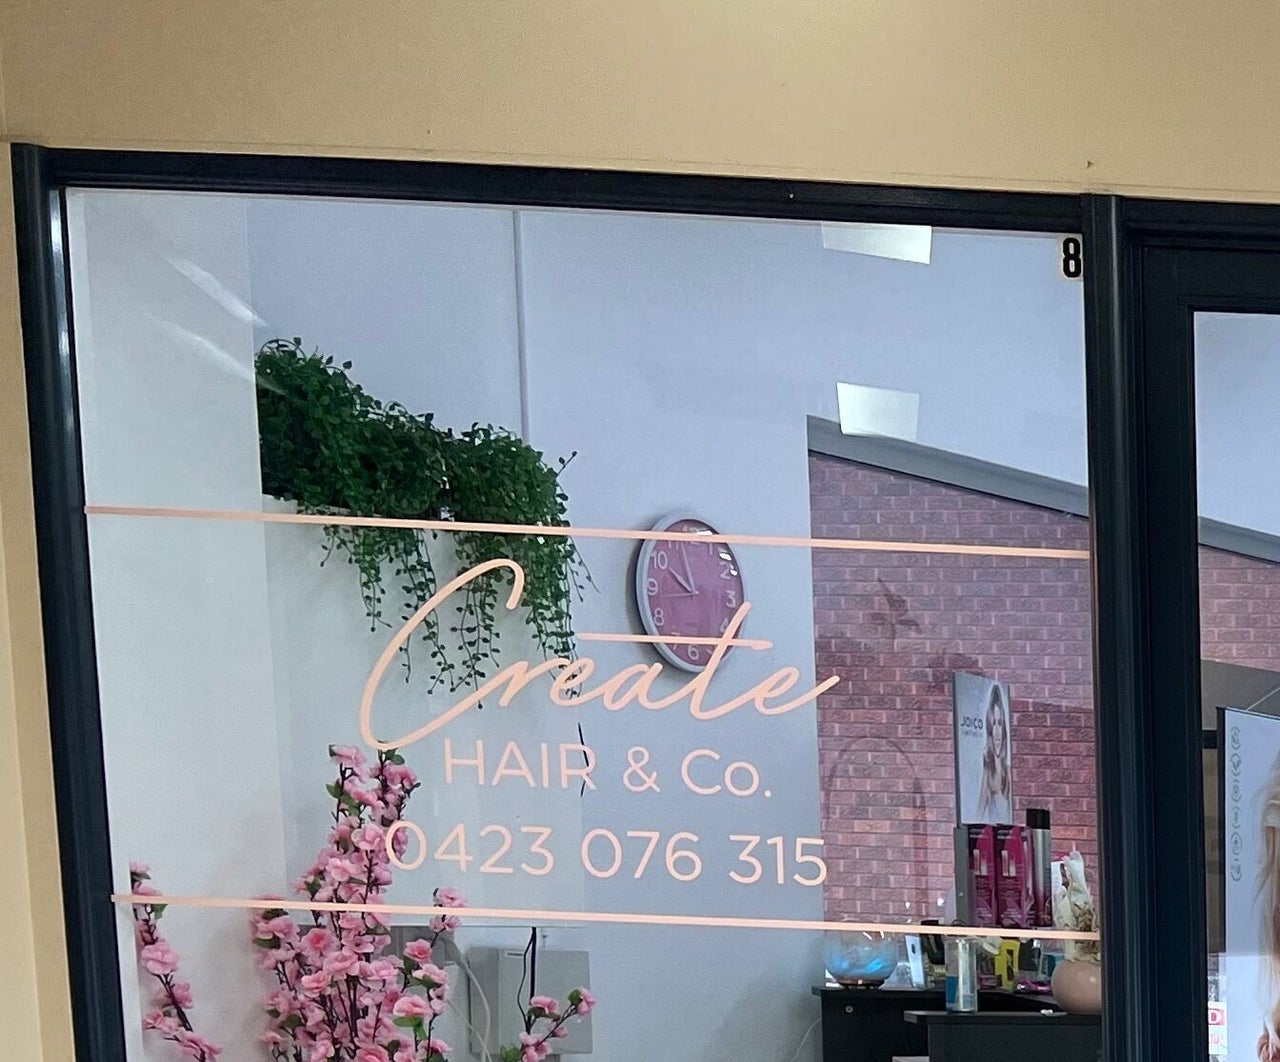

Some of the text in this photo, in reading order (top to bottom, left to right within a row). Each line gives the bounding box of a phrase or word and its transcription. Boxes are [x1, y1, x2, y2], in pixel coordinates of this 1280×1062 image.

[1063, 237, 1082, 278] 8
[651, 550, 669, 570] 10
[646, 578, 658, 596] 9
[725, 590, 737, 608] 3
[653, 607, 665, 627] 8
[359, 557, 841, 750] Create
[687, 644, 700, 661] 6
[444, 737, 773, 798] HAIR & Co.
[385, 820, 828, 887] 0423 076 315
